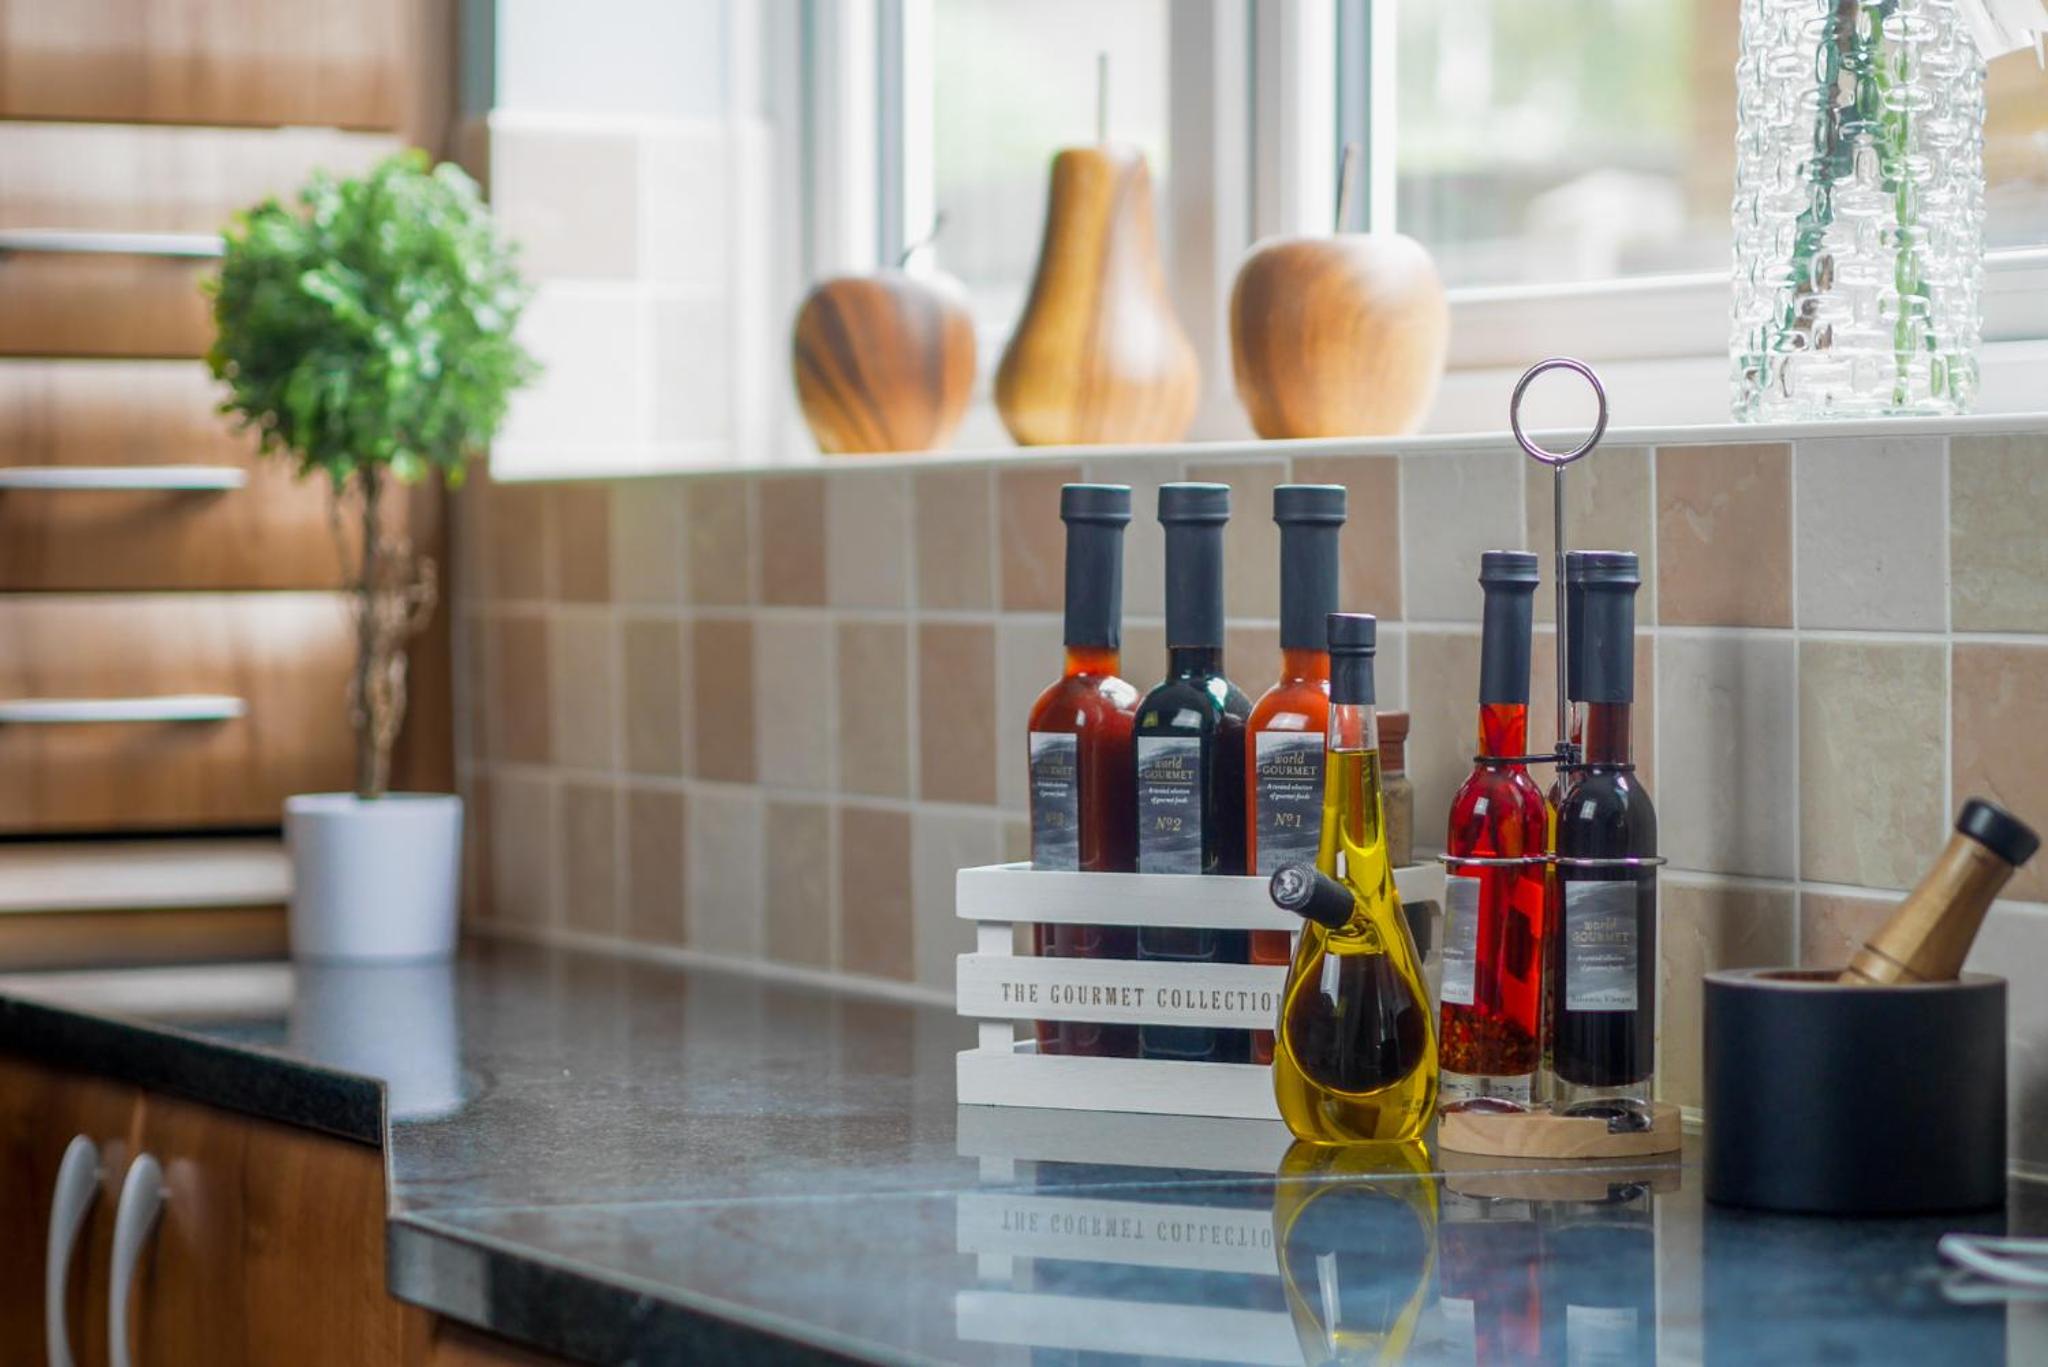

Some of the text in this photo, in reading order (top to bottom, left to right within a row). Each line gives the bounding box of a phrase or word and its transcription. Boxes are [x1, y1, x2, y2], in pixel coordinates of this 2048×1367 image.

[1274, 751, 1305, 765] world
[1143, 769, 1194, 780] GOURMET
[1262, 765, 1318, 776] GOURMET
[1001, 982, 1039, 1004] THE
[1049, 984, 1145, 1008] GOURMET
